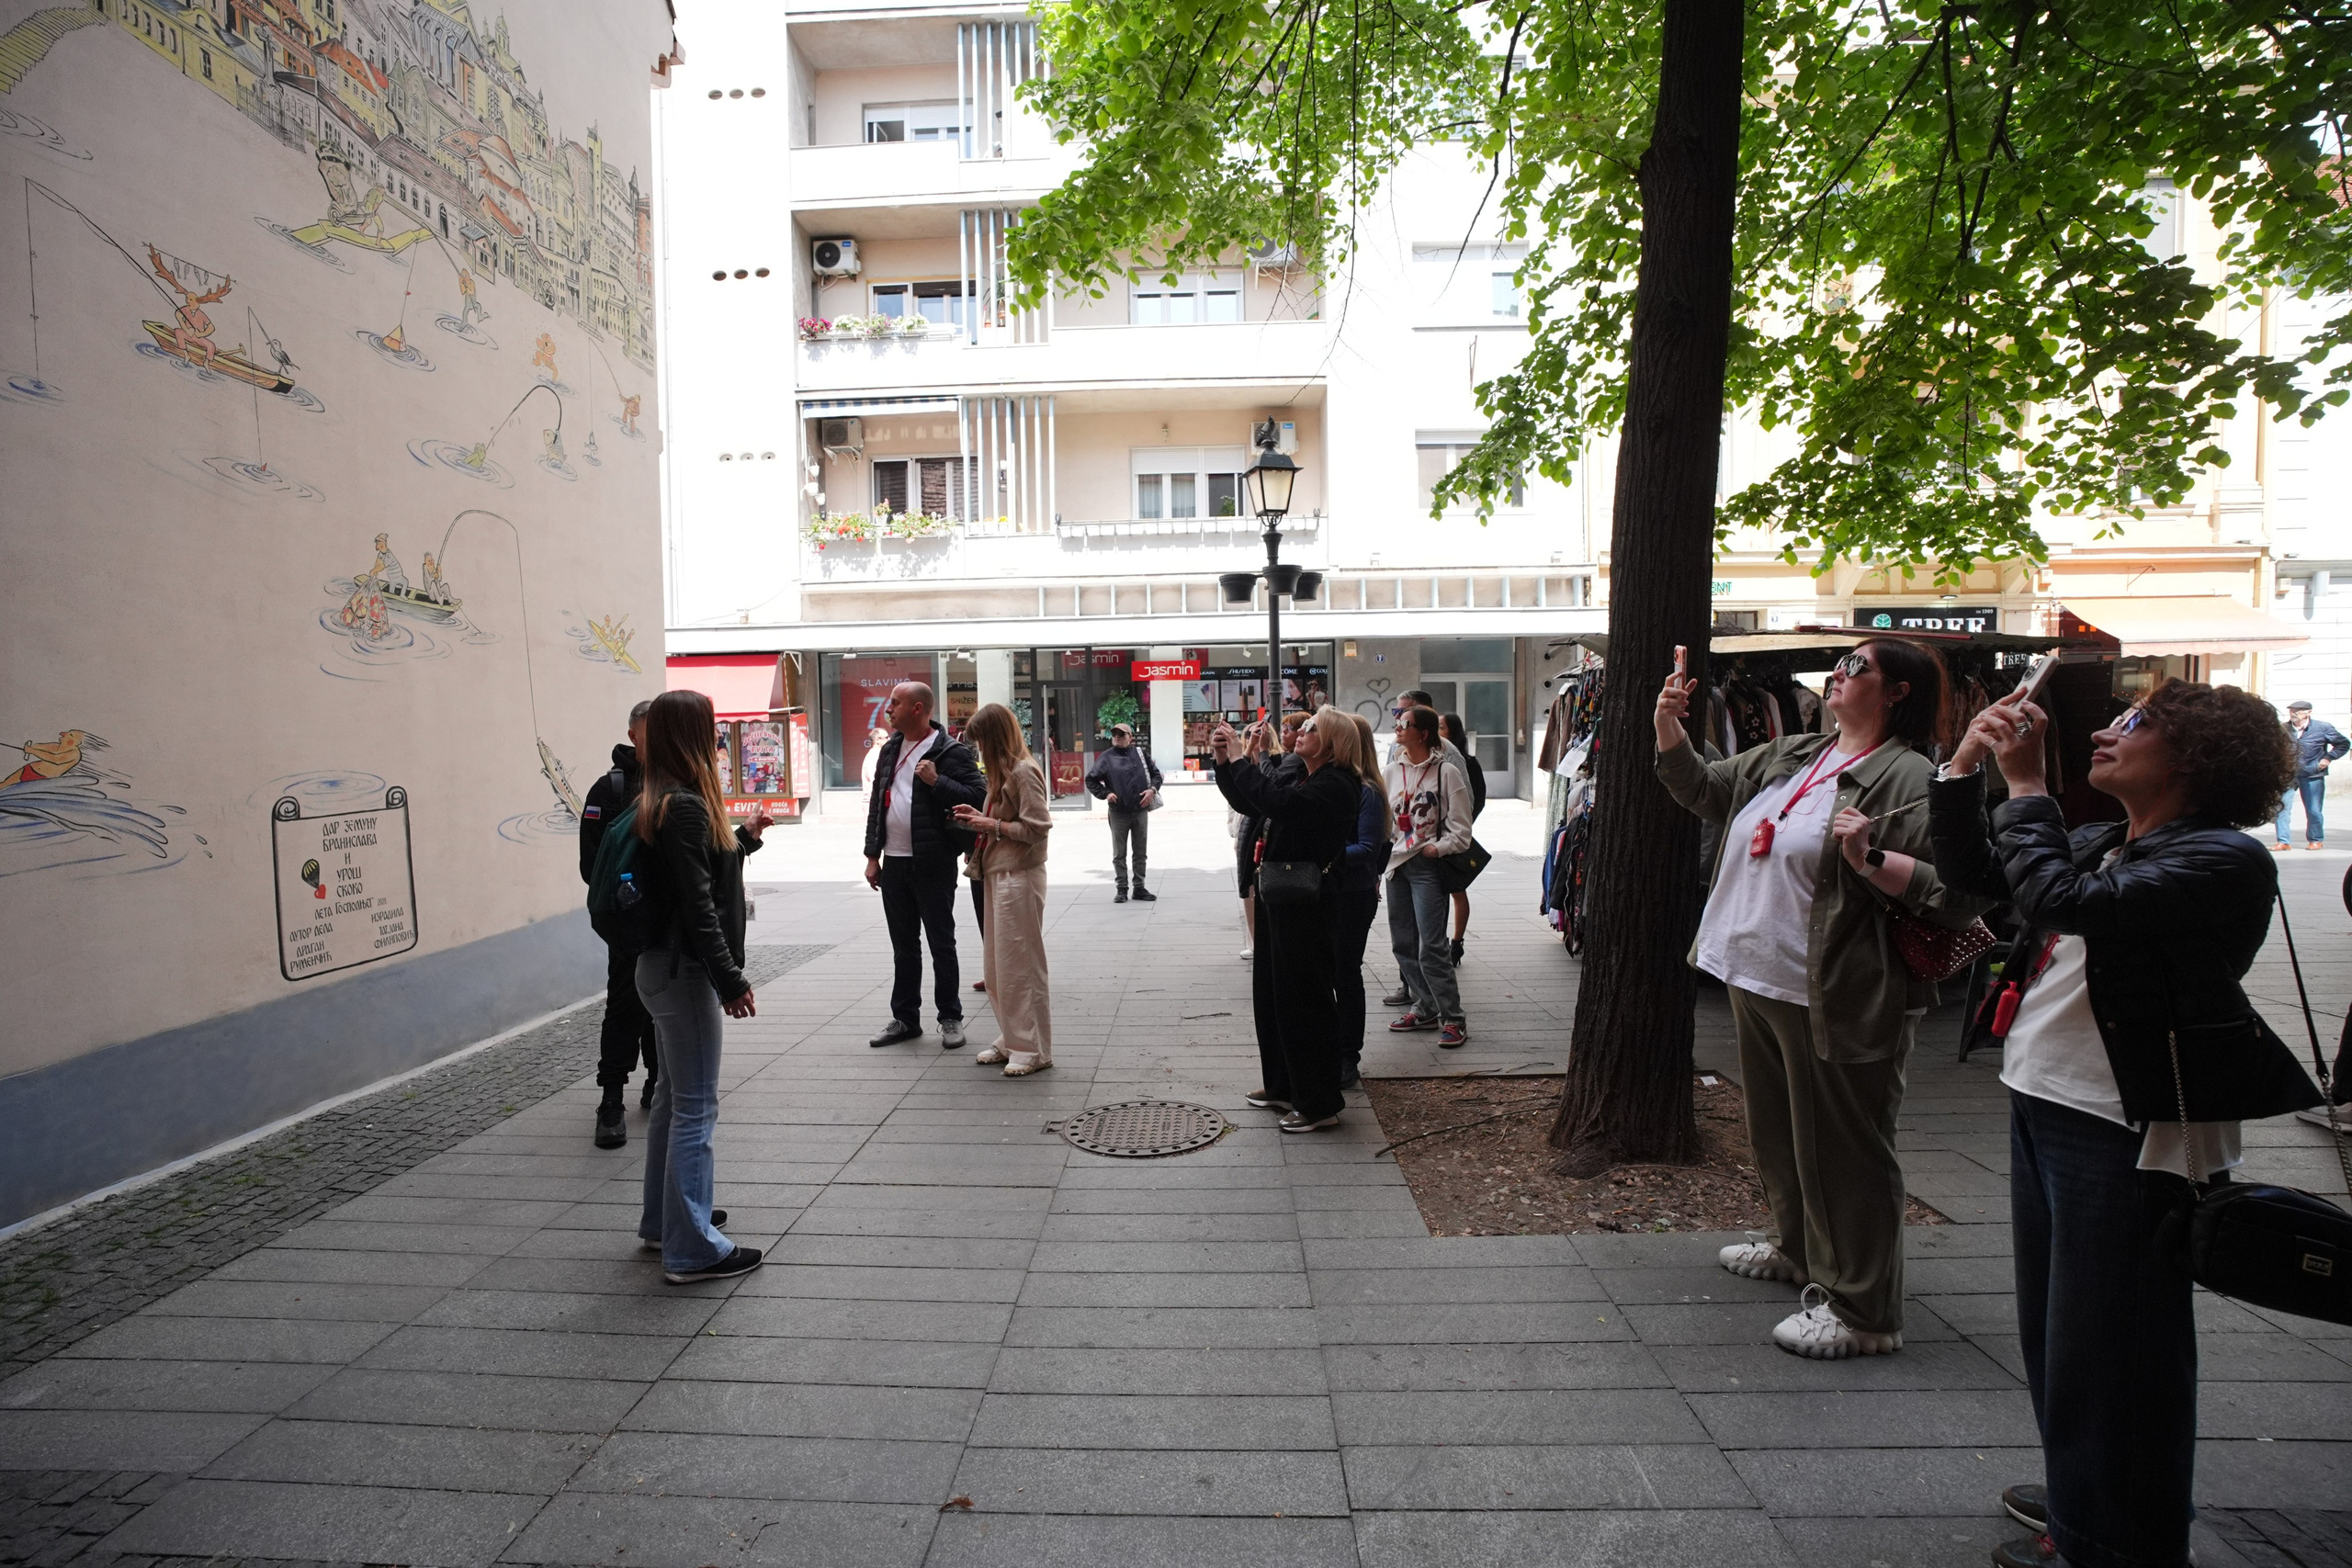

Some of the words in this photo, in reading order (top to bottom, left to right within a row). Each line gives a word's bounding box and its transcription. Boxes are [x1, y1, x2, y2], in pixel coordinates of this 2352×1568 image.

[1138, 660, 1193, 678] Jasmin
[322, 821, 340, 837] ДАР
[344, 817, 378, 833] ЗЕМУНУ
[322, 833, 378, 852] БРАНИСЛАВА
[336, 866, 362, 882] УРОШ
[336, 882, 363, 897] СКОКО
